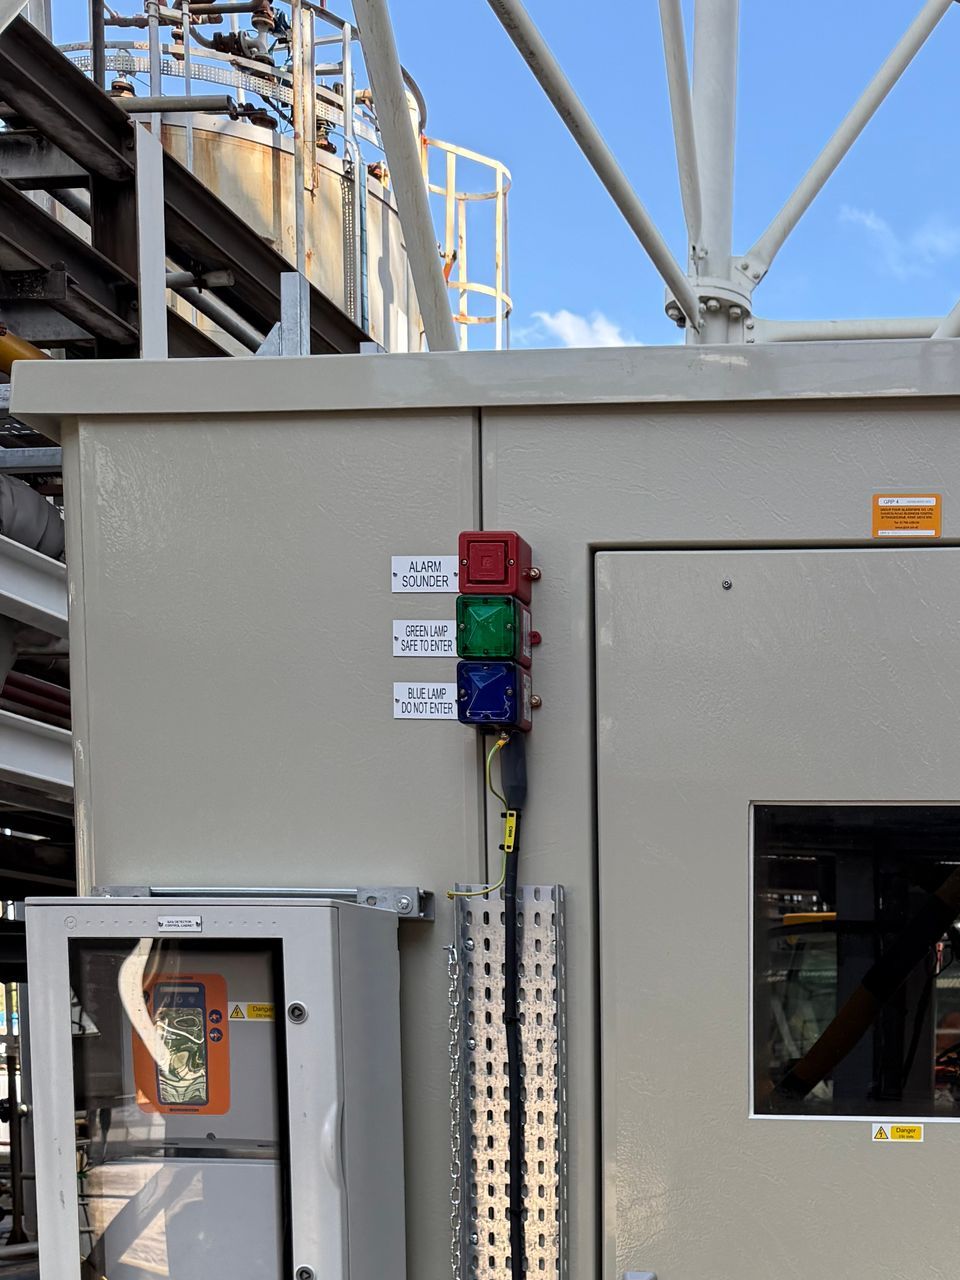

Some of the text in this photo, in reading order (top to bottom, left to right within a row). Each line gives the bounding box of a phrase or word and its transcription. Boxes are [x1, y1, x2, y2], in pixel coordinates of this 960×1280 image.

[408, 560, 442, 573] ALARM
[402, 575, 449, 587] SOUNDER
[405, 624, 448, 637] GREEN LAMP
[401, 639, 453, 652] SAFE TO ENTER
[407, 687, 447, 700] BLUE LAMP
[401, 701, 453, 714] DO NOT ENTER
